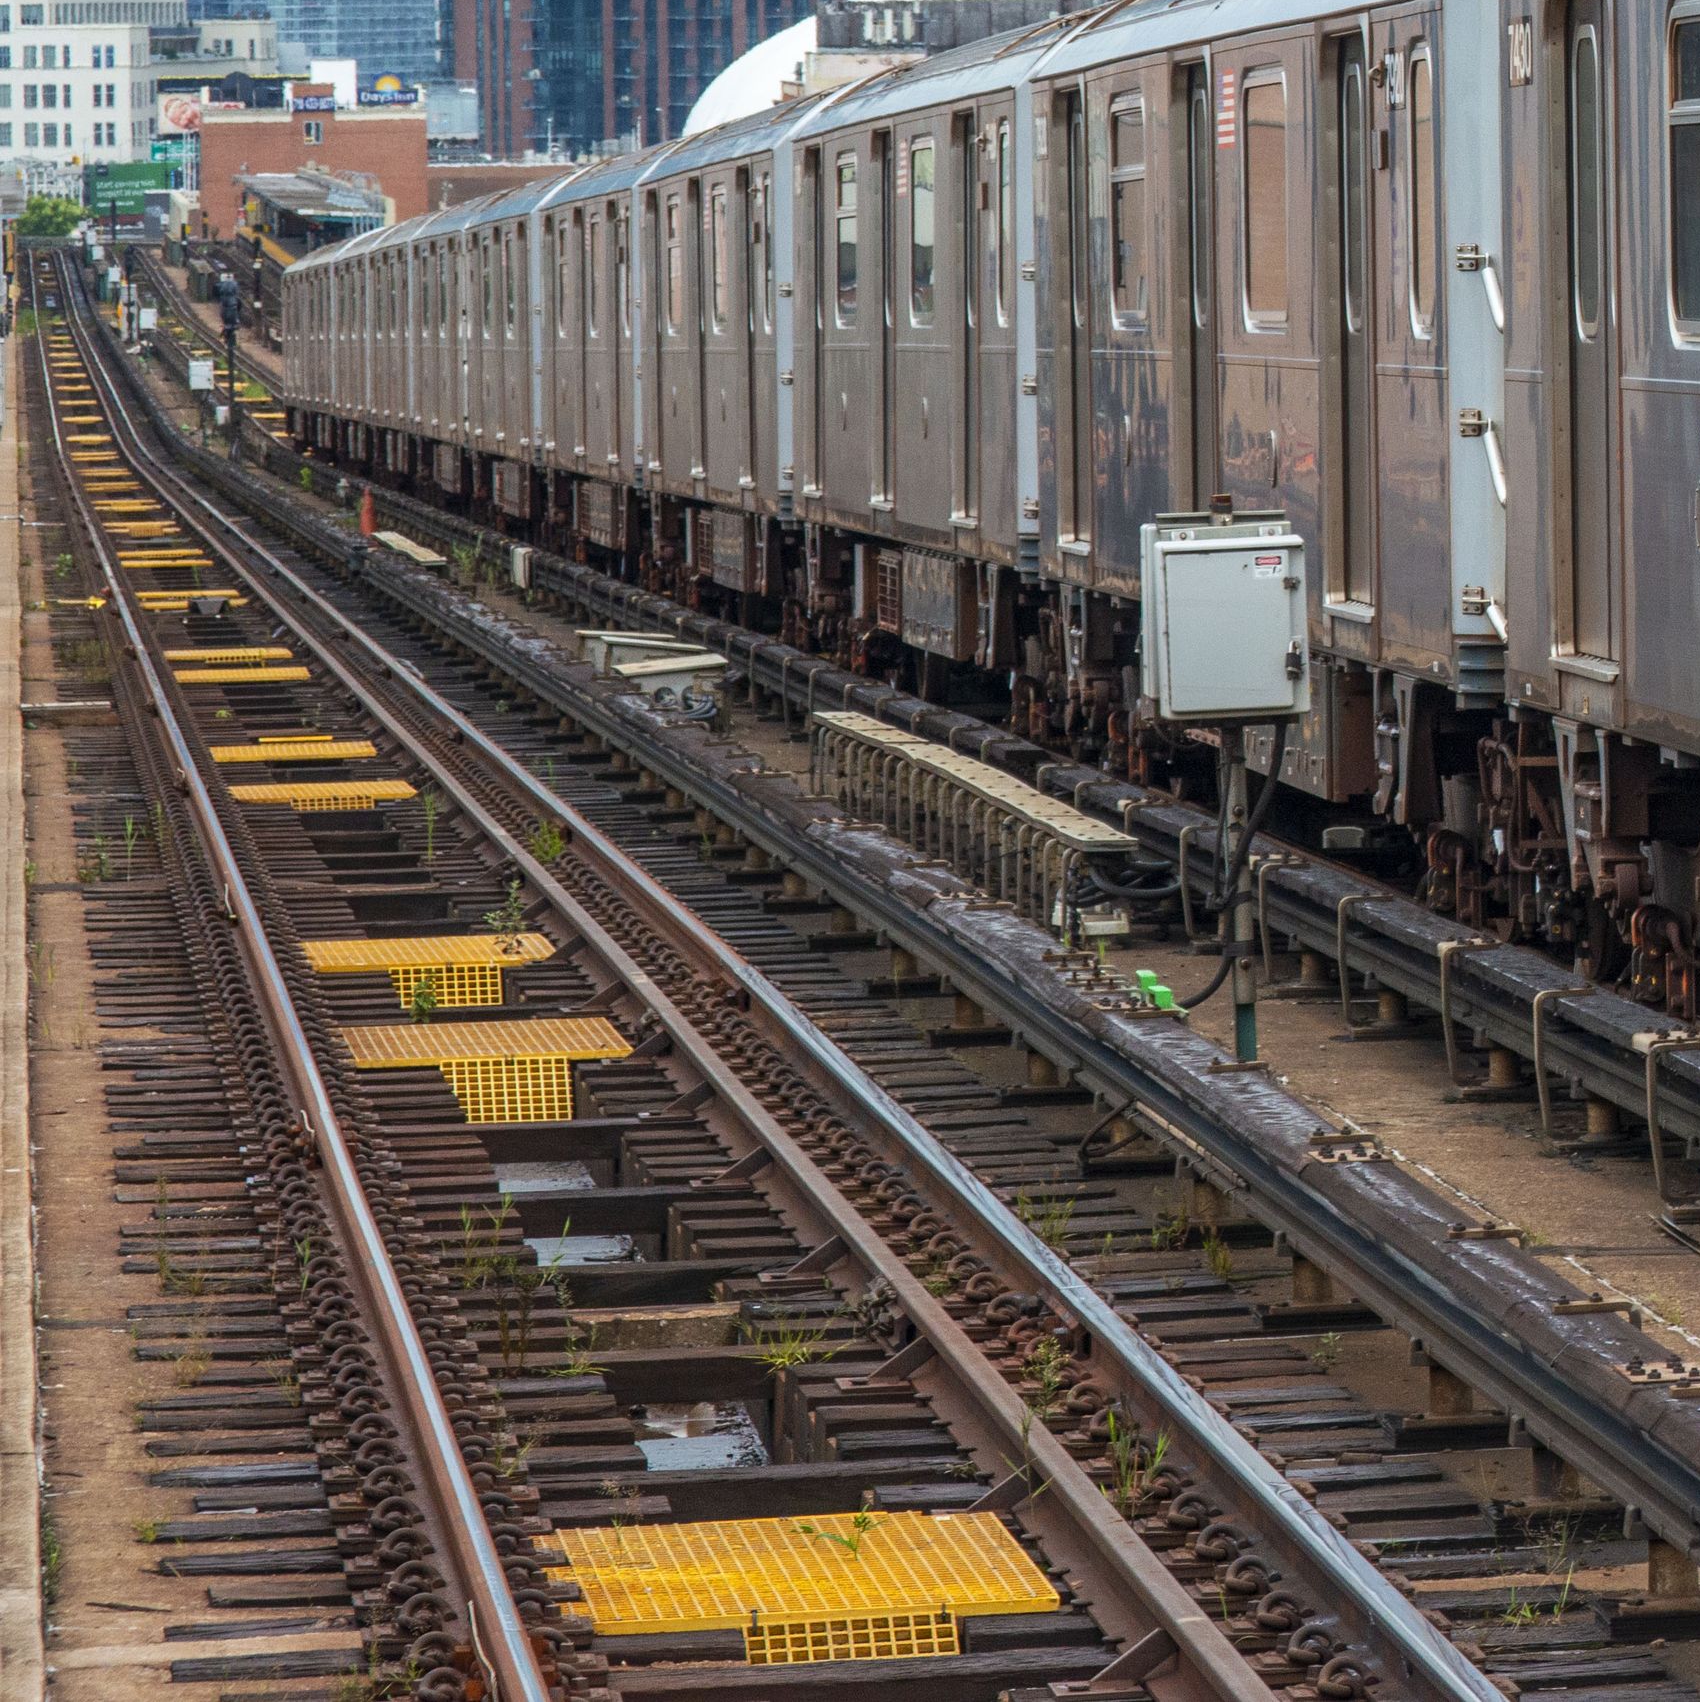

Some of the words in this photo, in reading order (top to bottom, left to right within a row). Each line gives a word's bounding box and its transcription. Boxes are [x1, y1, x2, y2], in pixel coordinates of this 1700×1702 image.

[1508, 23, 1531, 80] 7430
[361, 92, 392, 103] Days
[394, 92, 415, 100] Inn
